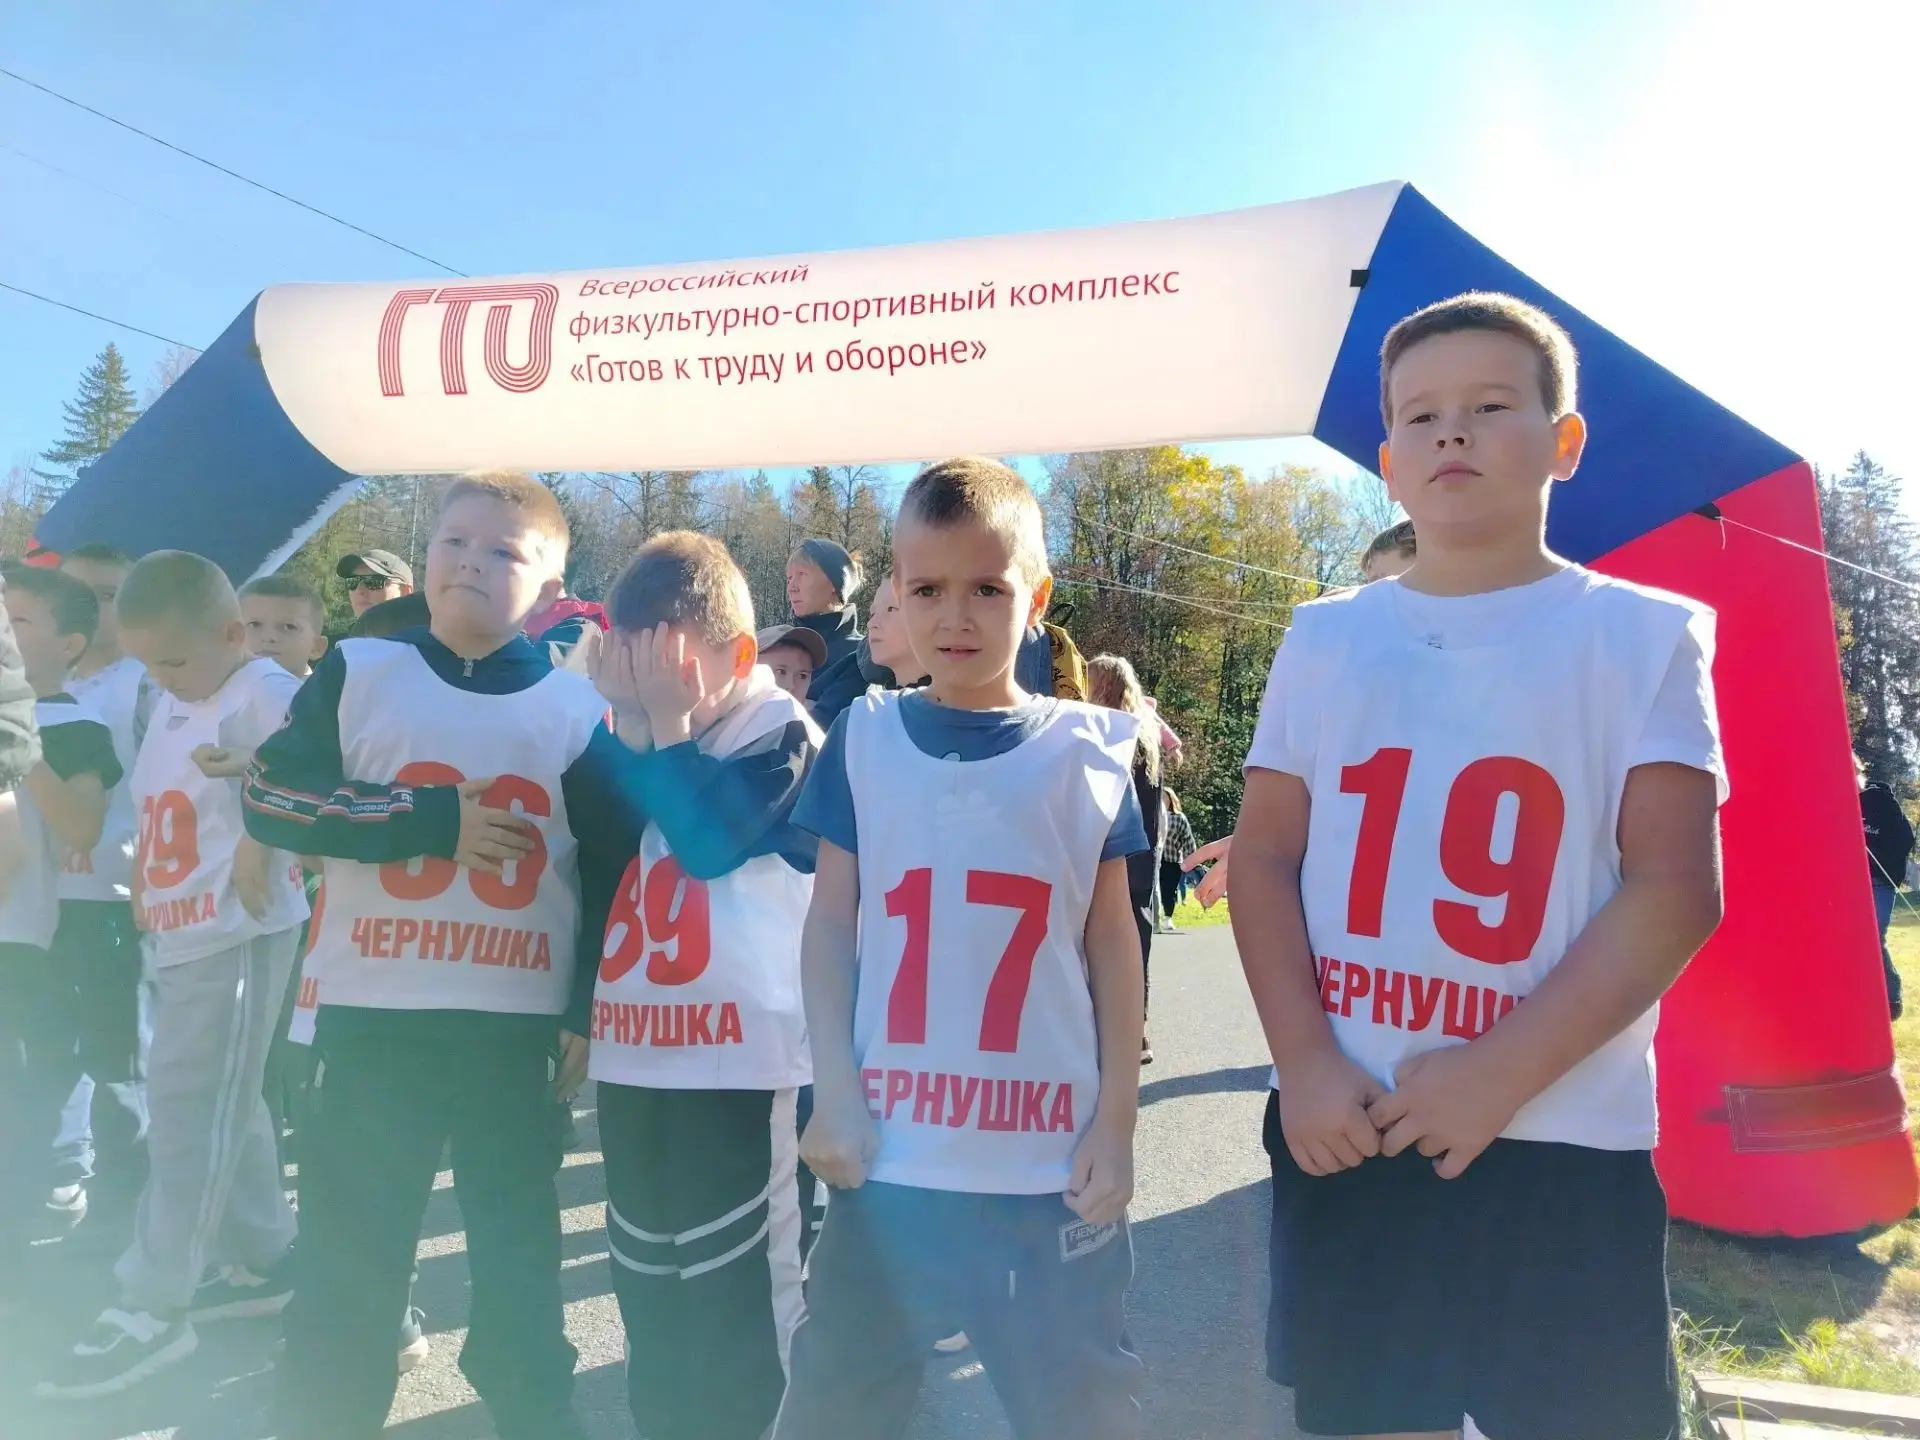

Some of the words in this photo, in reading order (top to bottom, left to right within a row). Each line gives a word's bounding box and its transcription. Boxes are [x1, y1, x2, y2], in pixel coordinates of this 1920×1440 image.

[569, 280, 996, 343] физкультурно-спортивный
[1010, 270, 1181, 308] комплекс
[579, 264, 809, 299] Всероссийский
[378, 282, 559, 397] ГТО
[570, 354, 664, 384] «Готов
[674, 357, 692, 381] к
[698, 352, 785, 386] труду
[796, 350, 814, 374] и
[825, 339, 987, 377] обороне»
[1340, 747, 1565, 965] 19
[350, 917, 552, 971] ЧЕРНУШКА
[598, 854, 711, 986] 89
[884, 867, 1052, 1053] 17
[591, 999, 743, 1047] ЕРНУШКА
[1312, 953, 1526, 1042] ЧЕРНУШ
[861, 1067, 1074, 1133] ЕРНУШКА
